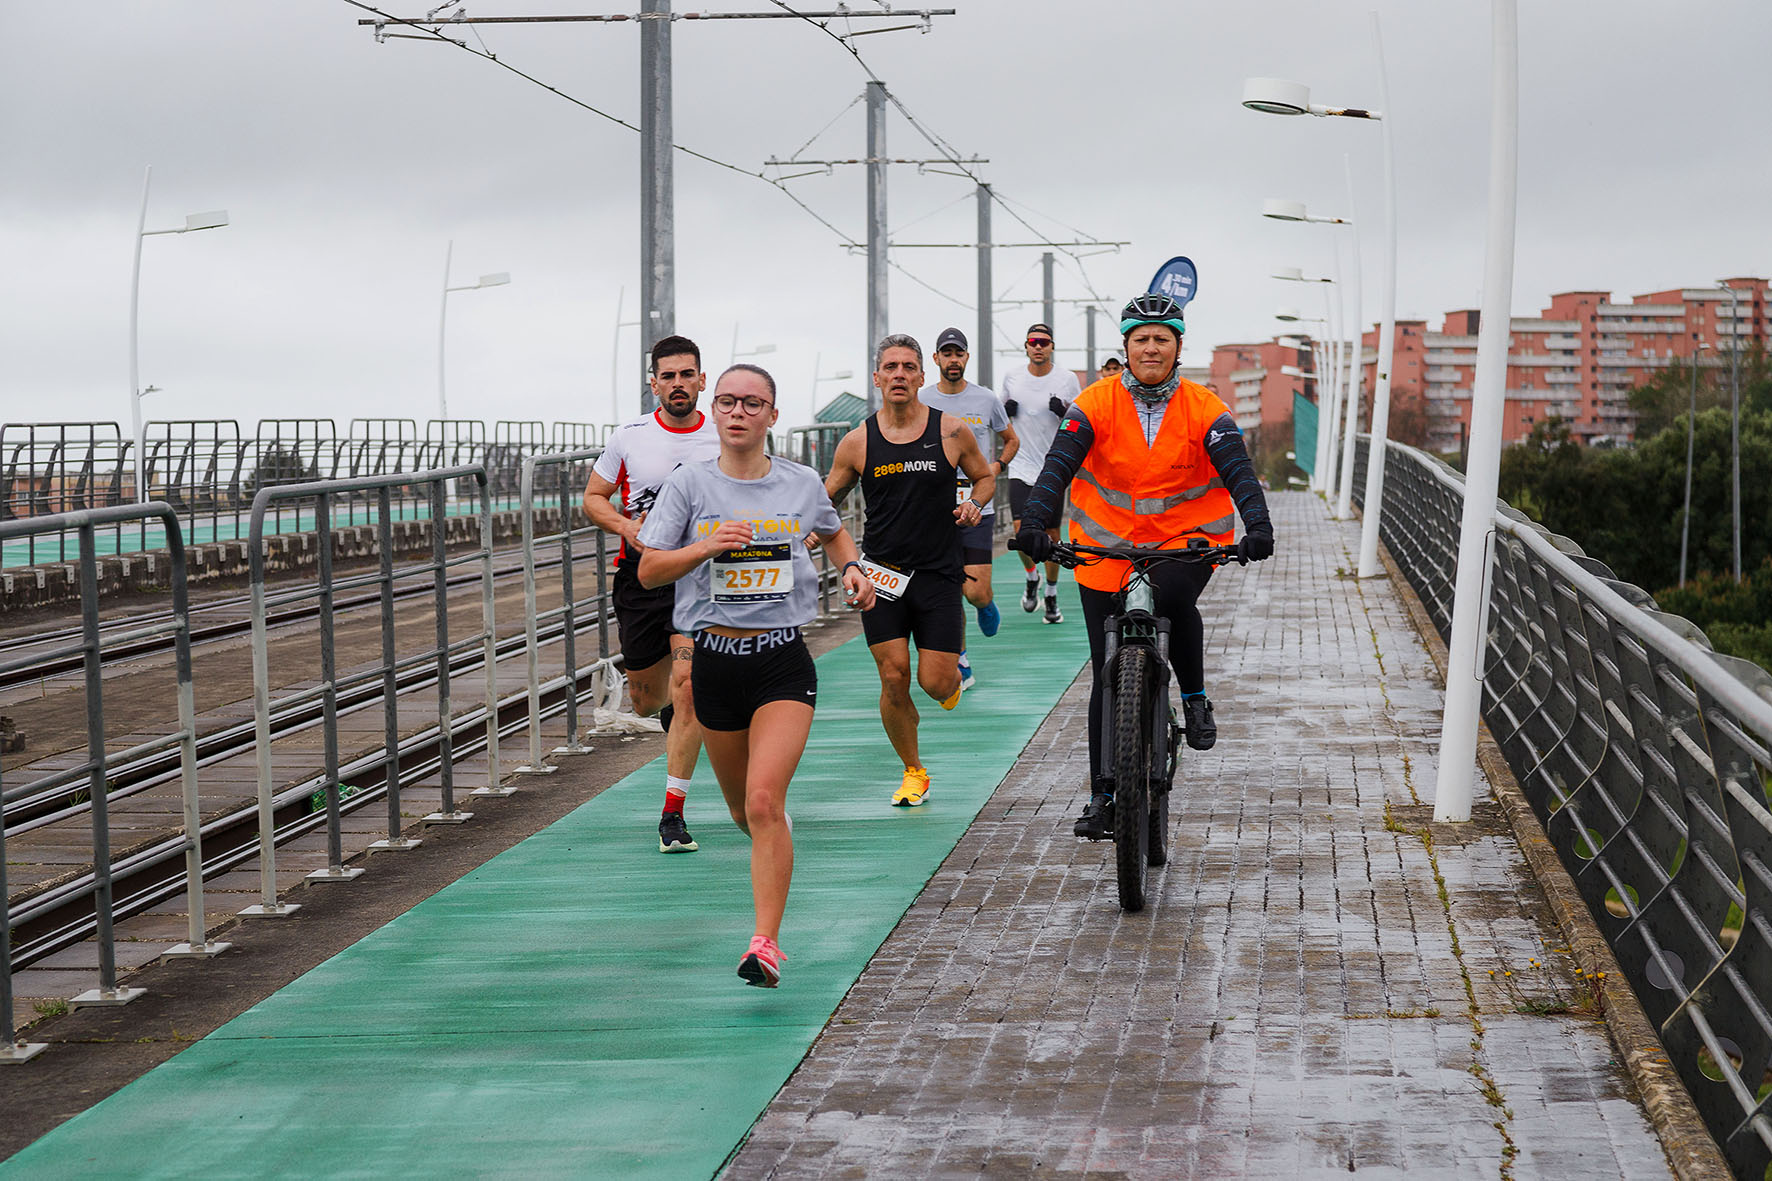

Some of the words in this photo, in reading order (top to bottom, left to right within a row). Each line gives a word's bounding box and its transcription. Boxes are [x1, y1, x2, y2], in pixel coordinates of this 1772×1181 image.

[730, 550, 773, 558] MARATONA
[725, 567, 780, 589] 2577
[866, 567, 899, 589] 2400
[703, 633, 752, 655] NIKE
